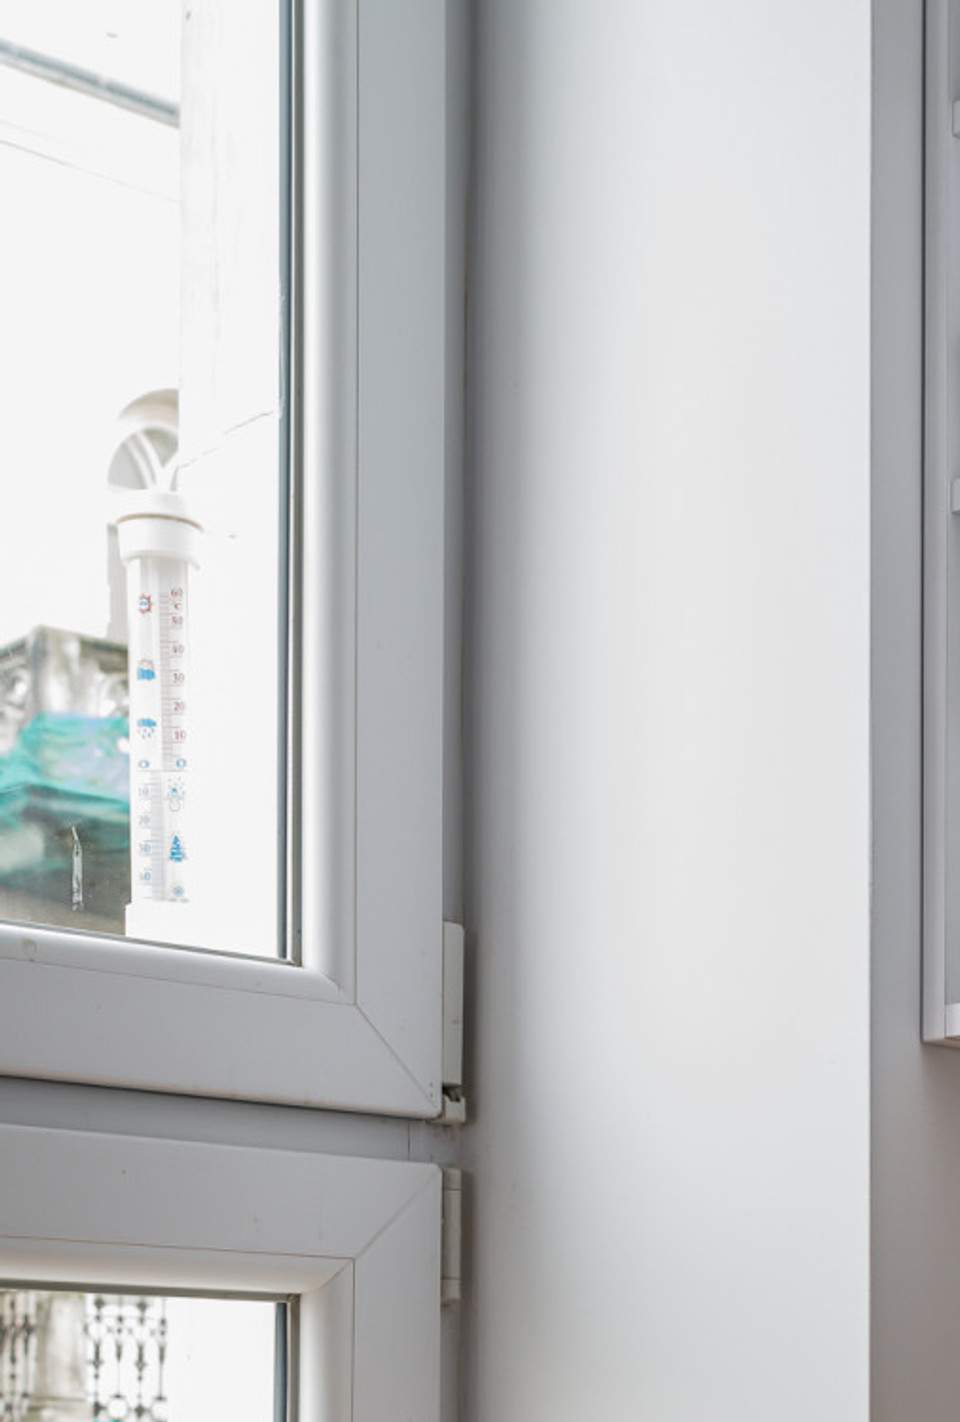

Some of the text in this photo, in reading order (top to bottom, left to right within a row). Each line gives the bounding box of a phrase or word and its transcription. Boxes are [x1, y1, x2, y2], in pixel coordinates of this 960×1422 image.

[172, 672, 185, 684] 30
[173, 701, 186, 712] 20
[173, 729, 187, 741] 10
